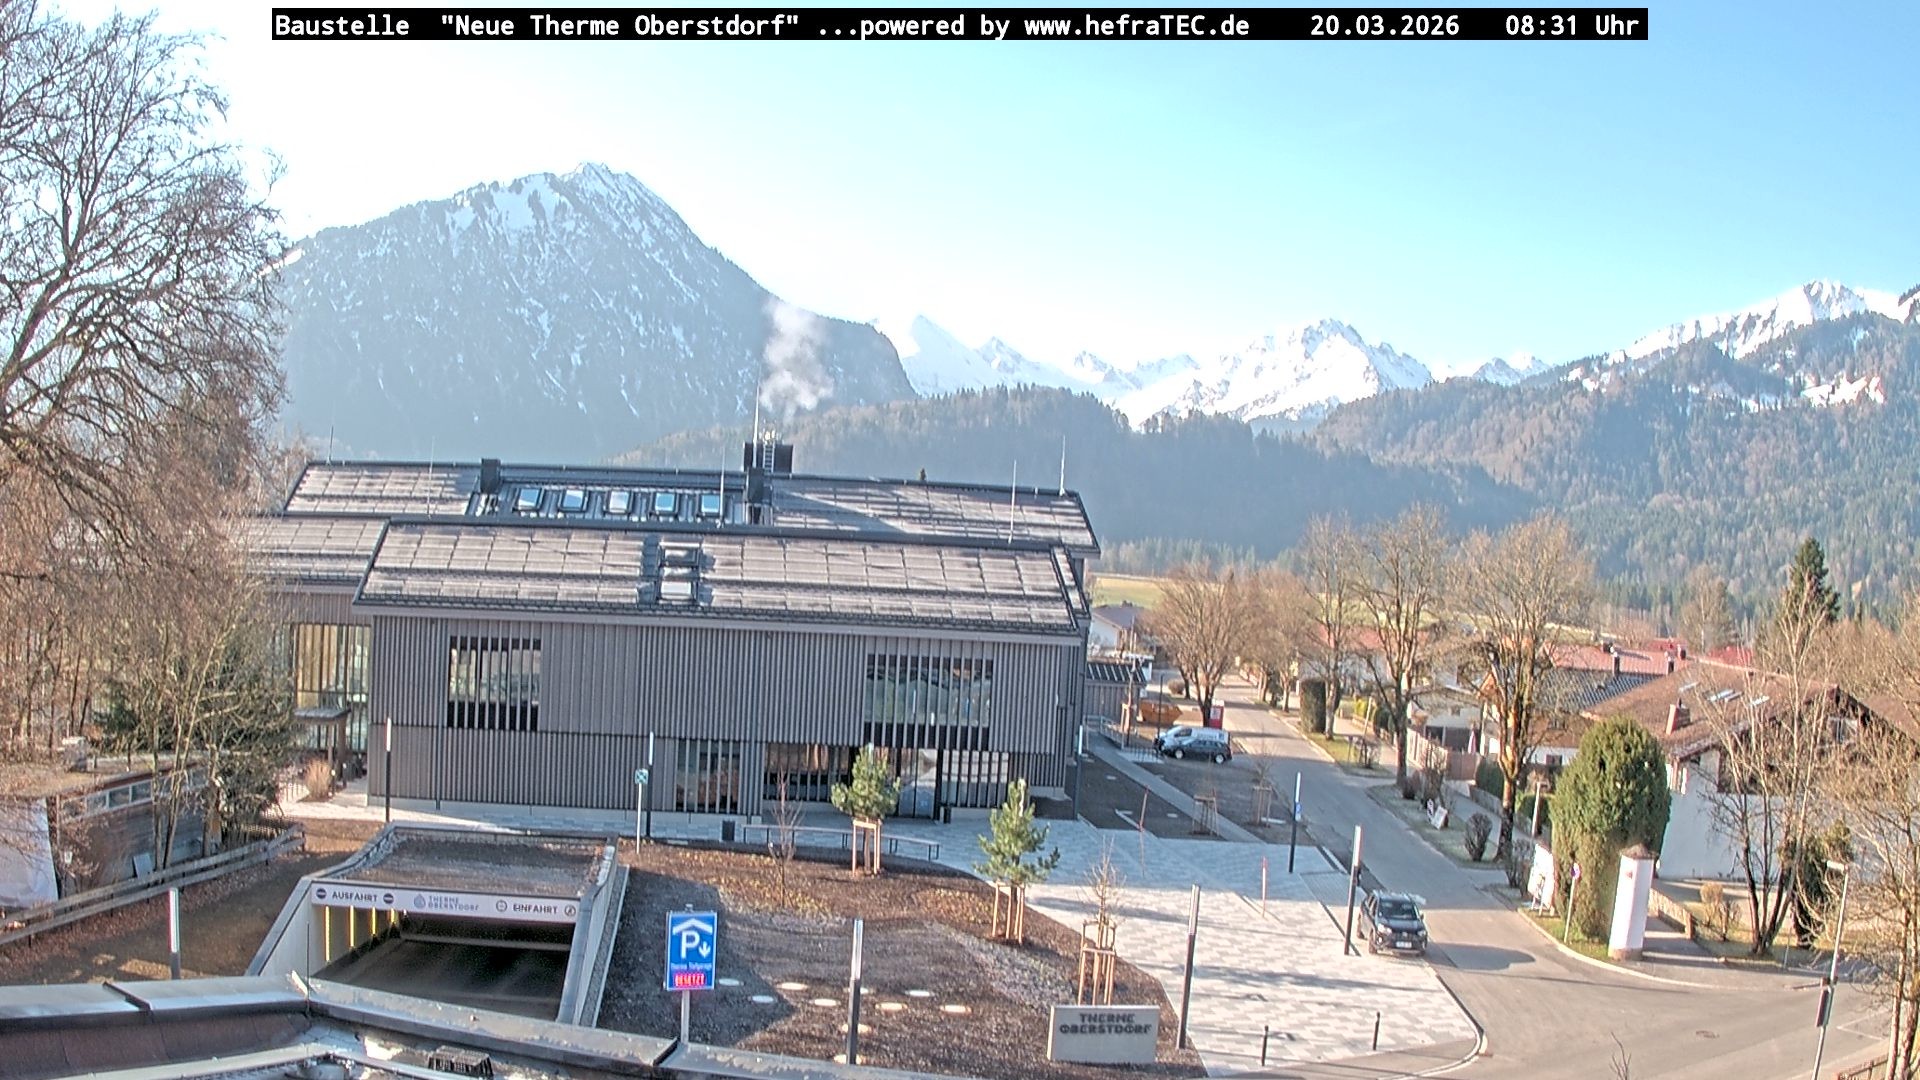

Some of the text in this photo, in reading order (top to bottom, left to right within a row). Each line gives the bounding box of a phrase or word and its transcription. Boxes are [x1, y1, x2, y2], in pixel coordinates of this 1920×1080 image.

[332, 891, 377, 902] AUSFAHRT
[513, 903, 558, 914] EINFAHRT
[681, 930, 700, 959] P
[1079, 1013, 1135, 1023] THERME
[1060, 1023, 1152, 1034] OBERSTDORF
